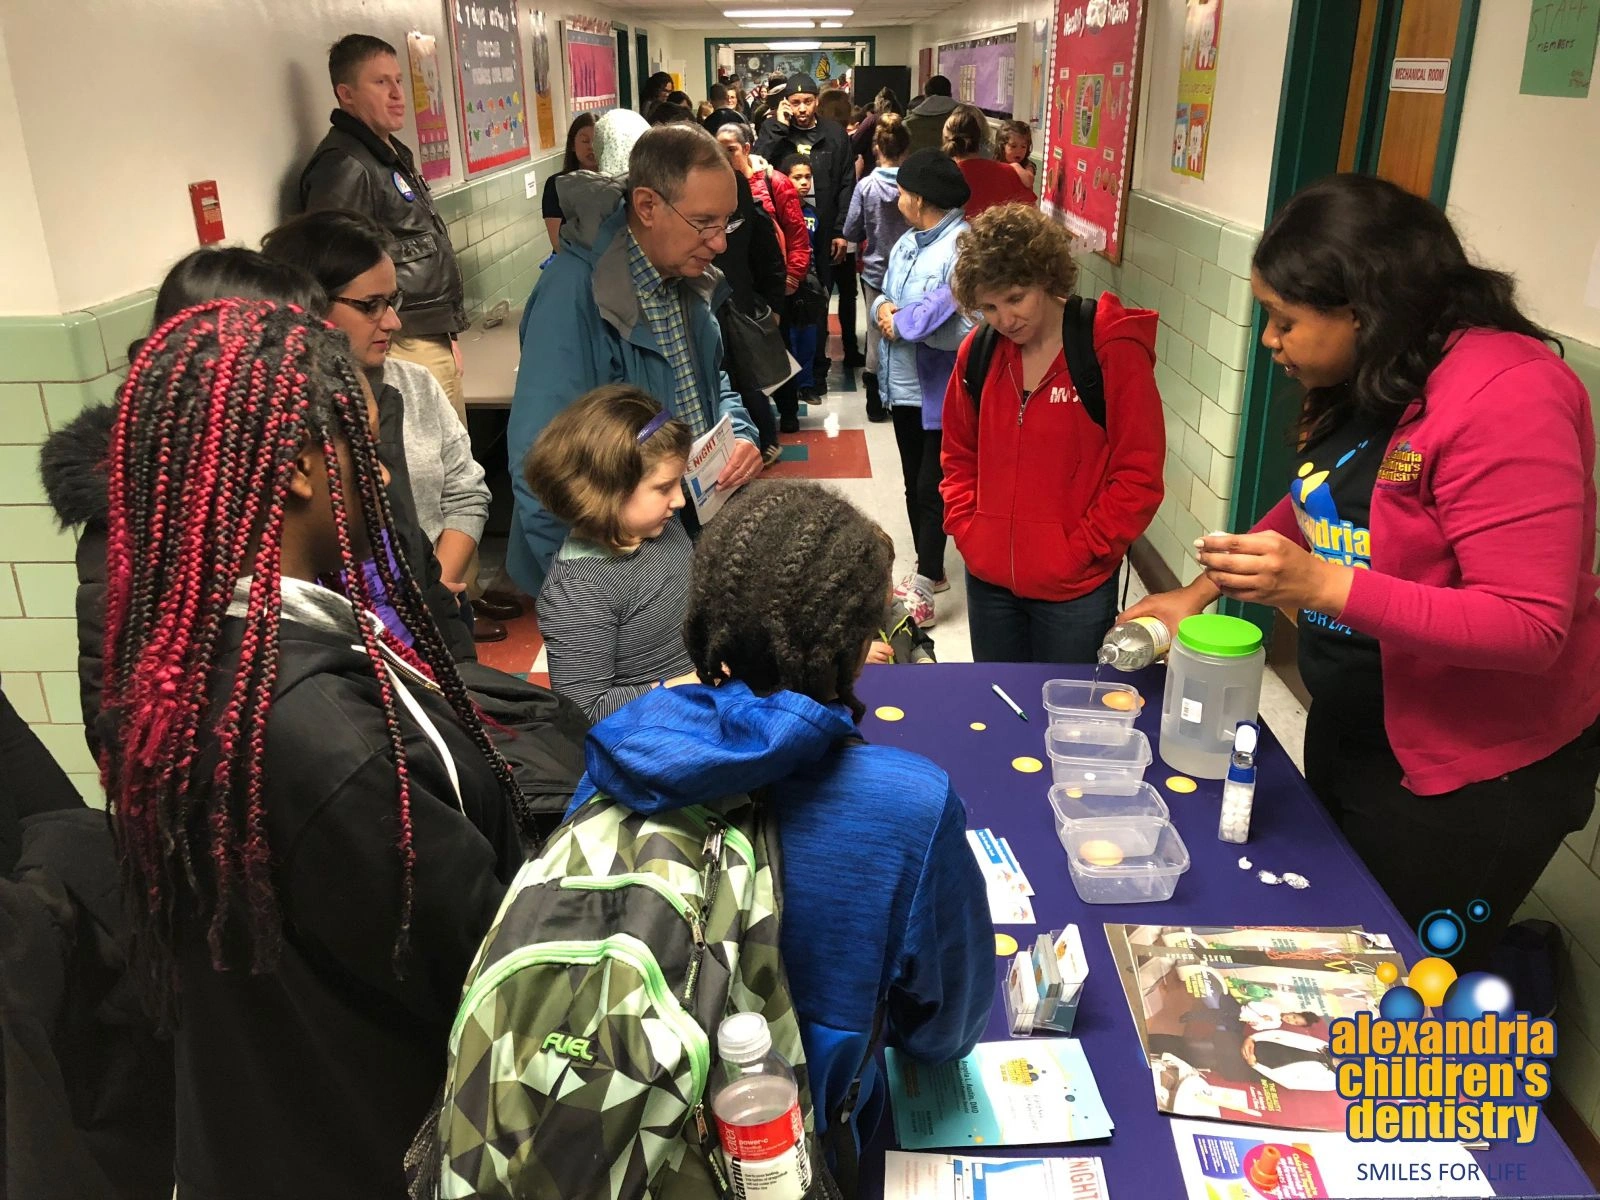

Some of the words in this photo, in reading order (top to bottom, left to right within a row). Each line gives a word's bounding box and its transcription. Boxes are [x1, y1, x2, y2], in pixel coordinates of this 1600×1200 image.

[1395, 68, 1425, 80] MECHANICAL
[1427, 69, 1445, 81] ROOM
[692, 436, 717, 469] NIGHT
[541, 1031, 594, 1061] FUEL
[961, 1060, 971, 1078] Angela
[970, 1101, 979, 1114] DMD
[1069, 1159, 1099, 1200] NIGHT
